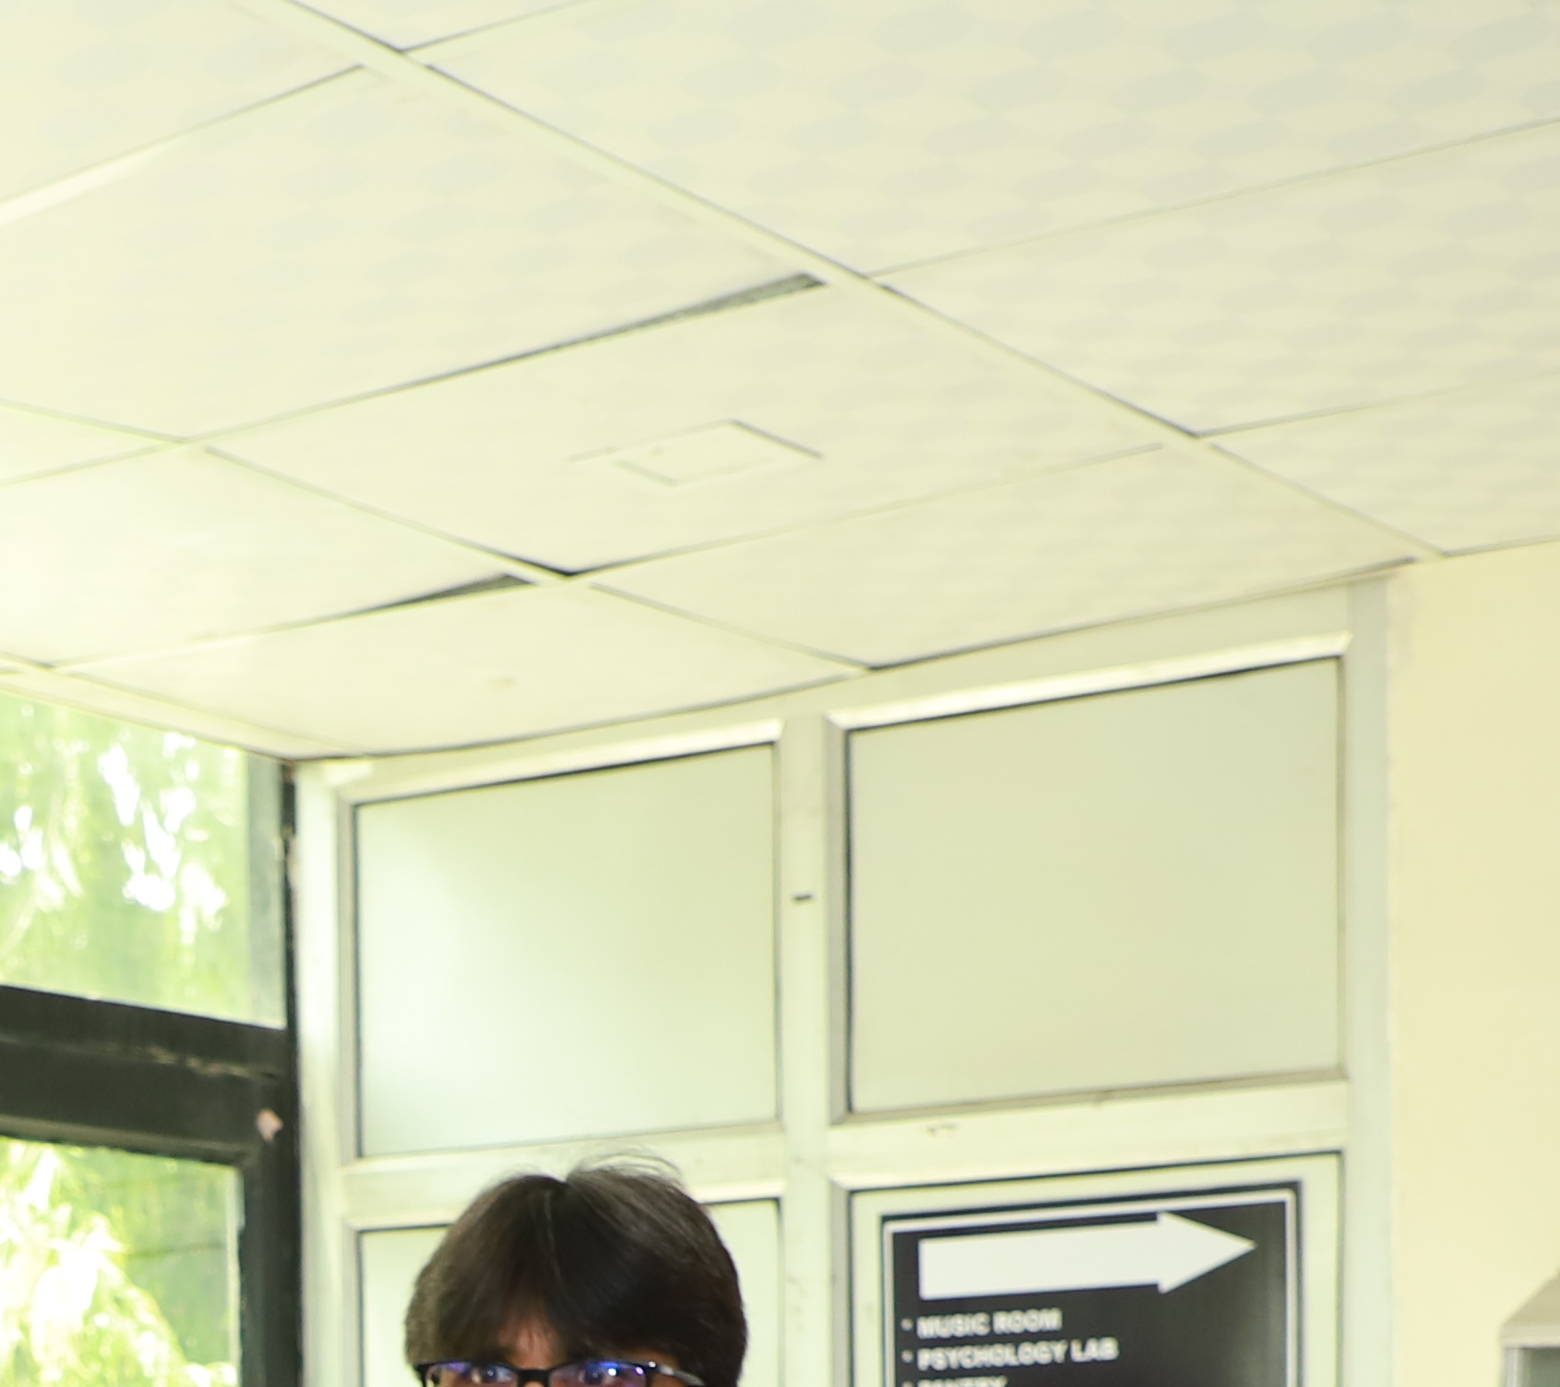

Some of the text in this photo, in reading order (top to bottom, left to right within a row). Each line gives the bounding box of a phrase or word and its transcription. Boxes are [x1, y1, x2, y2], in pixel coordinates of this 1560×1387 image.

[917, 1307, 1063, 1340] MUSIC ROOM
[917, 1337, 1120, 1372] PSYCHOLOGY LAB
